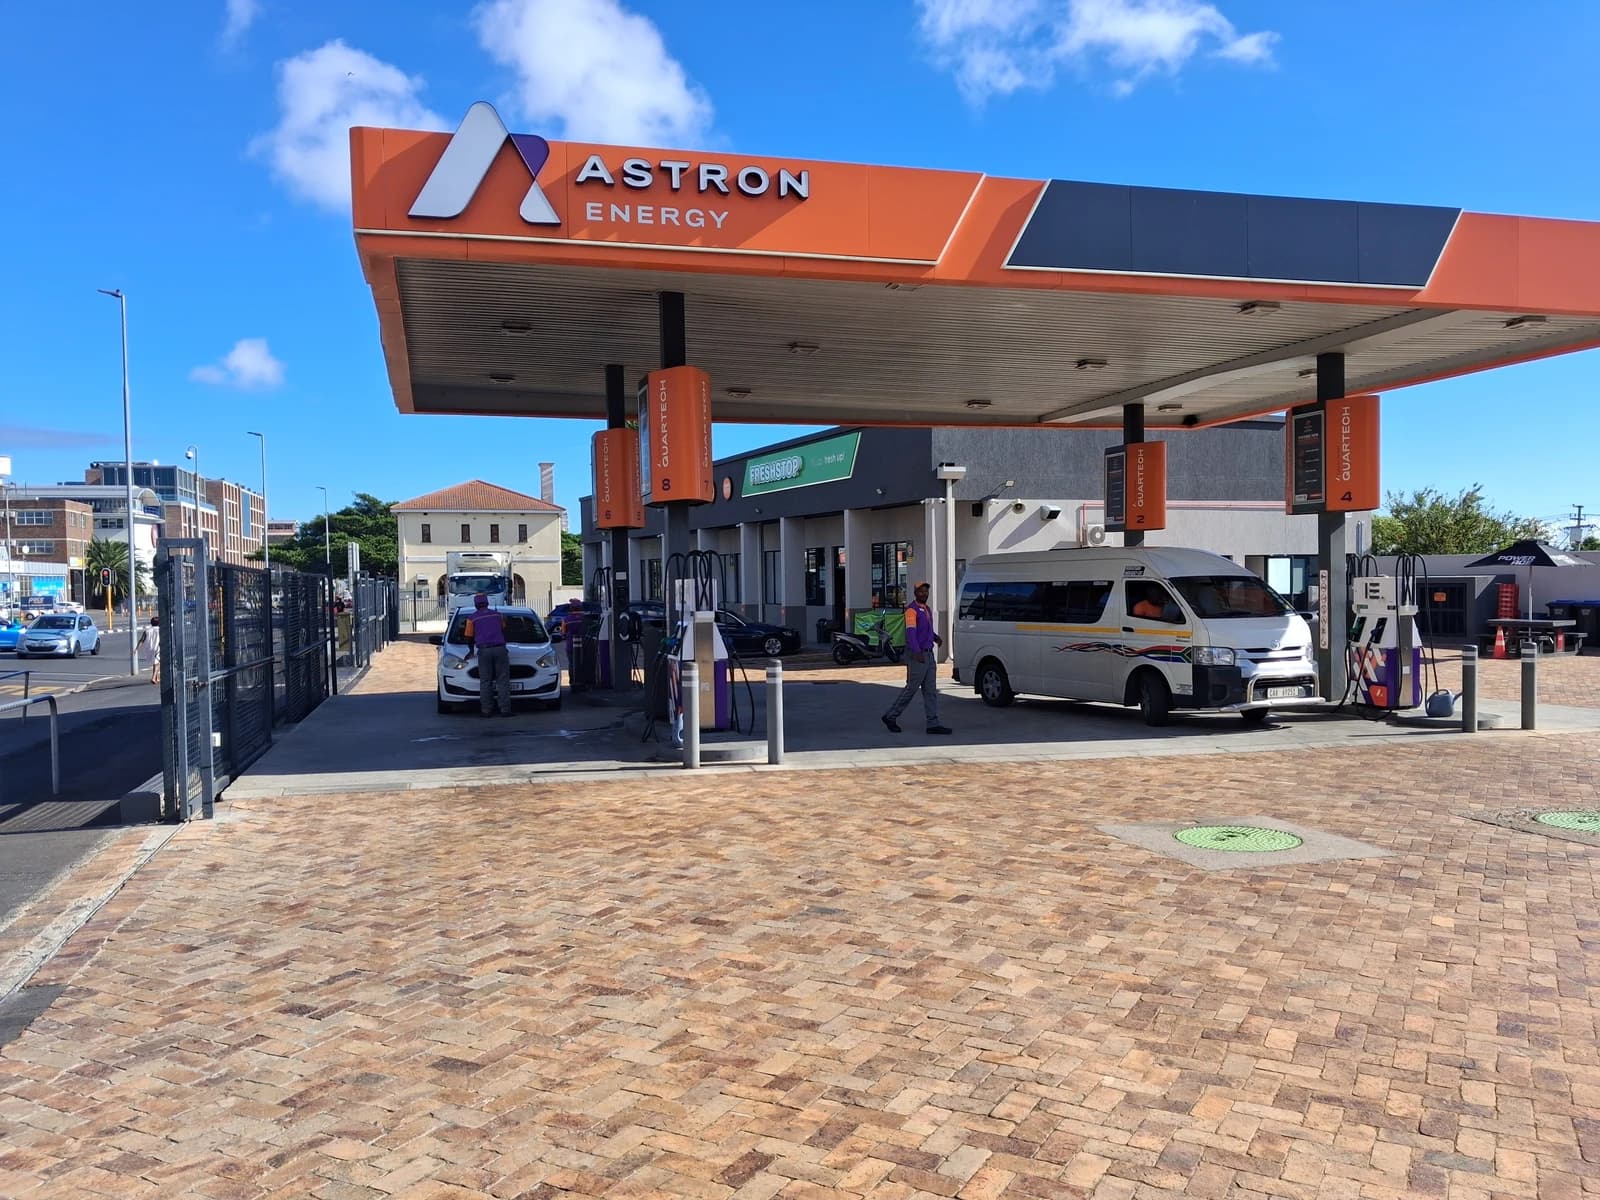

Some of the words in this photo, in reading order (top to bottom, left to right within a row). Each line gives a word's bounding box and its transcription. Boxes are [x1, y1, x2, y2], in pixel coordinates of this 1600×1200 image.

[575, 154, 809, 199] ASTRON
[585, 202, 729, 229] ENERGY
[660, 379, 669, 468] QUARTECH
[1342, 406, 1351, 481] QUARTECH
[661, 478, 671, 492] 8
[750, 456, 802, 485] FRESHSTOP
[1340, 491, 1353, 502] 4
